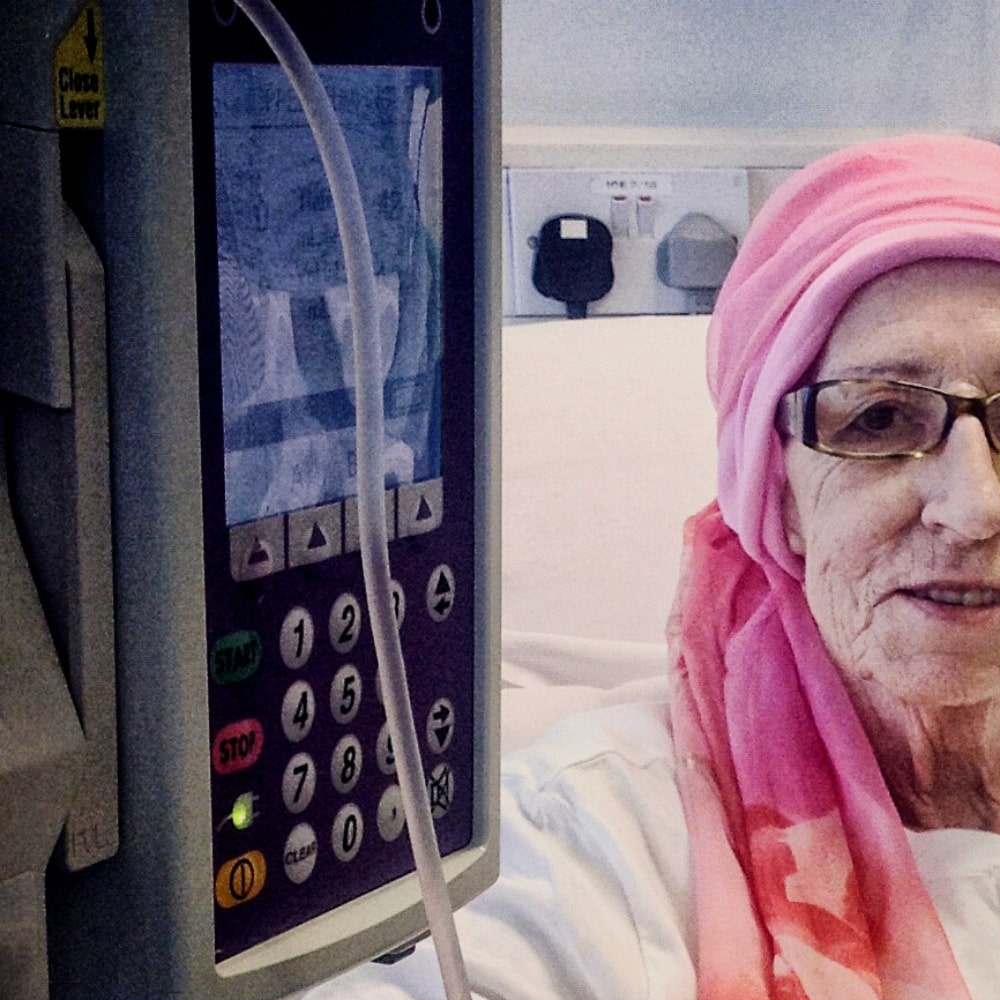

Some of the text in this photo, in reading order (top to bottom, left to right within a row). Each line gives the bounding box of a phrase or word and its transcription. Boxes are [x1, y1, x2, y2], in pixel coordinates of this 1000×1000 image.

[59, 66, 99, 93] Close
[60, 95, 100, 120] Lever
[293, 618, 305, 658] 1
[338, 604, 355, 643] 2
[215, 639, 257, 675] START
[293, 690, 308, 729] 4
[340, 675, 355, 715] 5
[219, 730, 255, 764] STOP
[341, 745, 355, 784] 8
[293, 763, 309, 803] 7
[342, 814, 357, 852] 0
